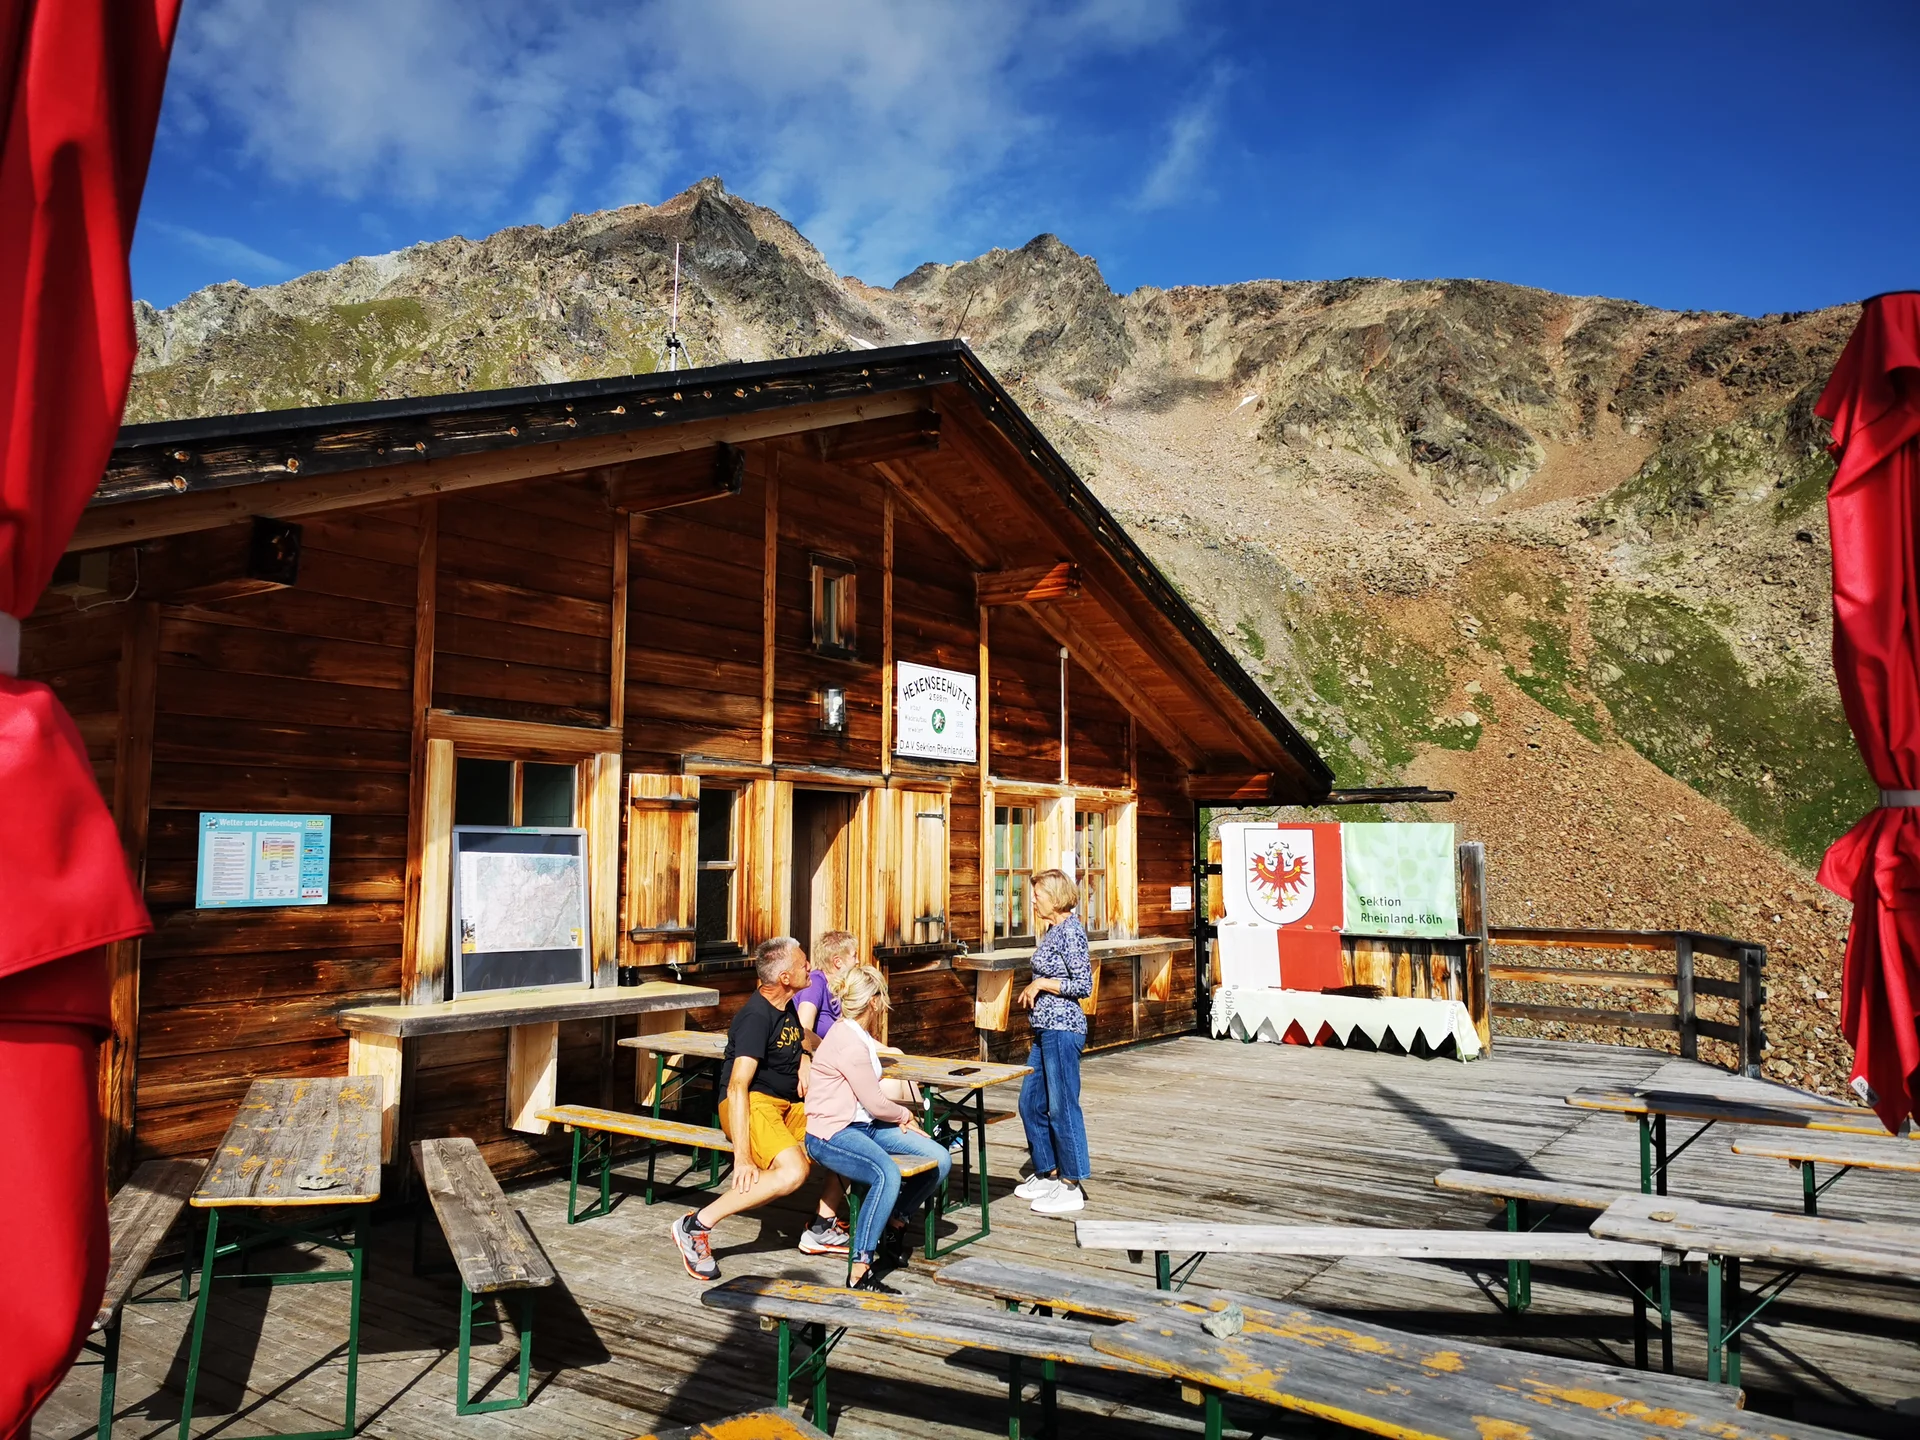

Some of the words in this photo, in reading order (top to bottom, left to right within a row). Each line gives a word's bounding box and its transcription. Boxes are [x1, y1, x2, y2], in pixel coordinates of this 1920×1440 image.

[902, 675, 973, 711] HEXENSEEHÜTTE
[219, 818, 243, 827] Wetter
[245, 819, 258, 827] und
[259, 819, 302, 829] Lawinenlage
[1359, 895, 1402, 908] Sektion
[1360, 912, 1443, 925] Rheinland-Köln
